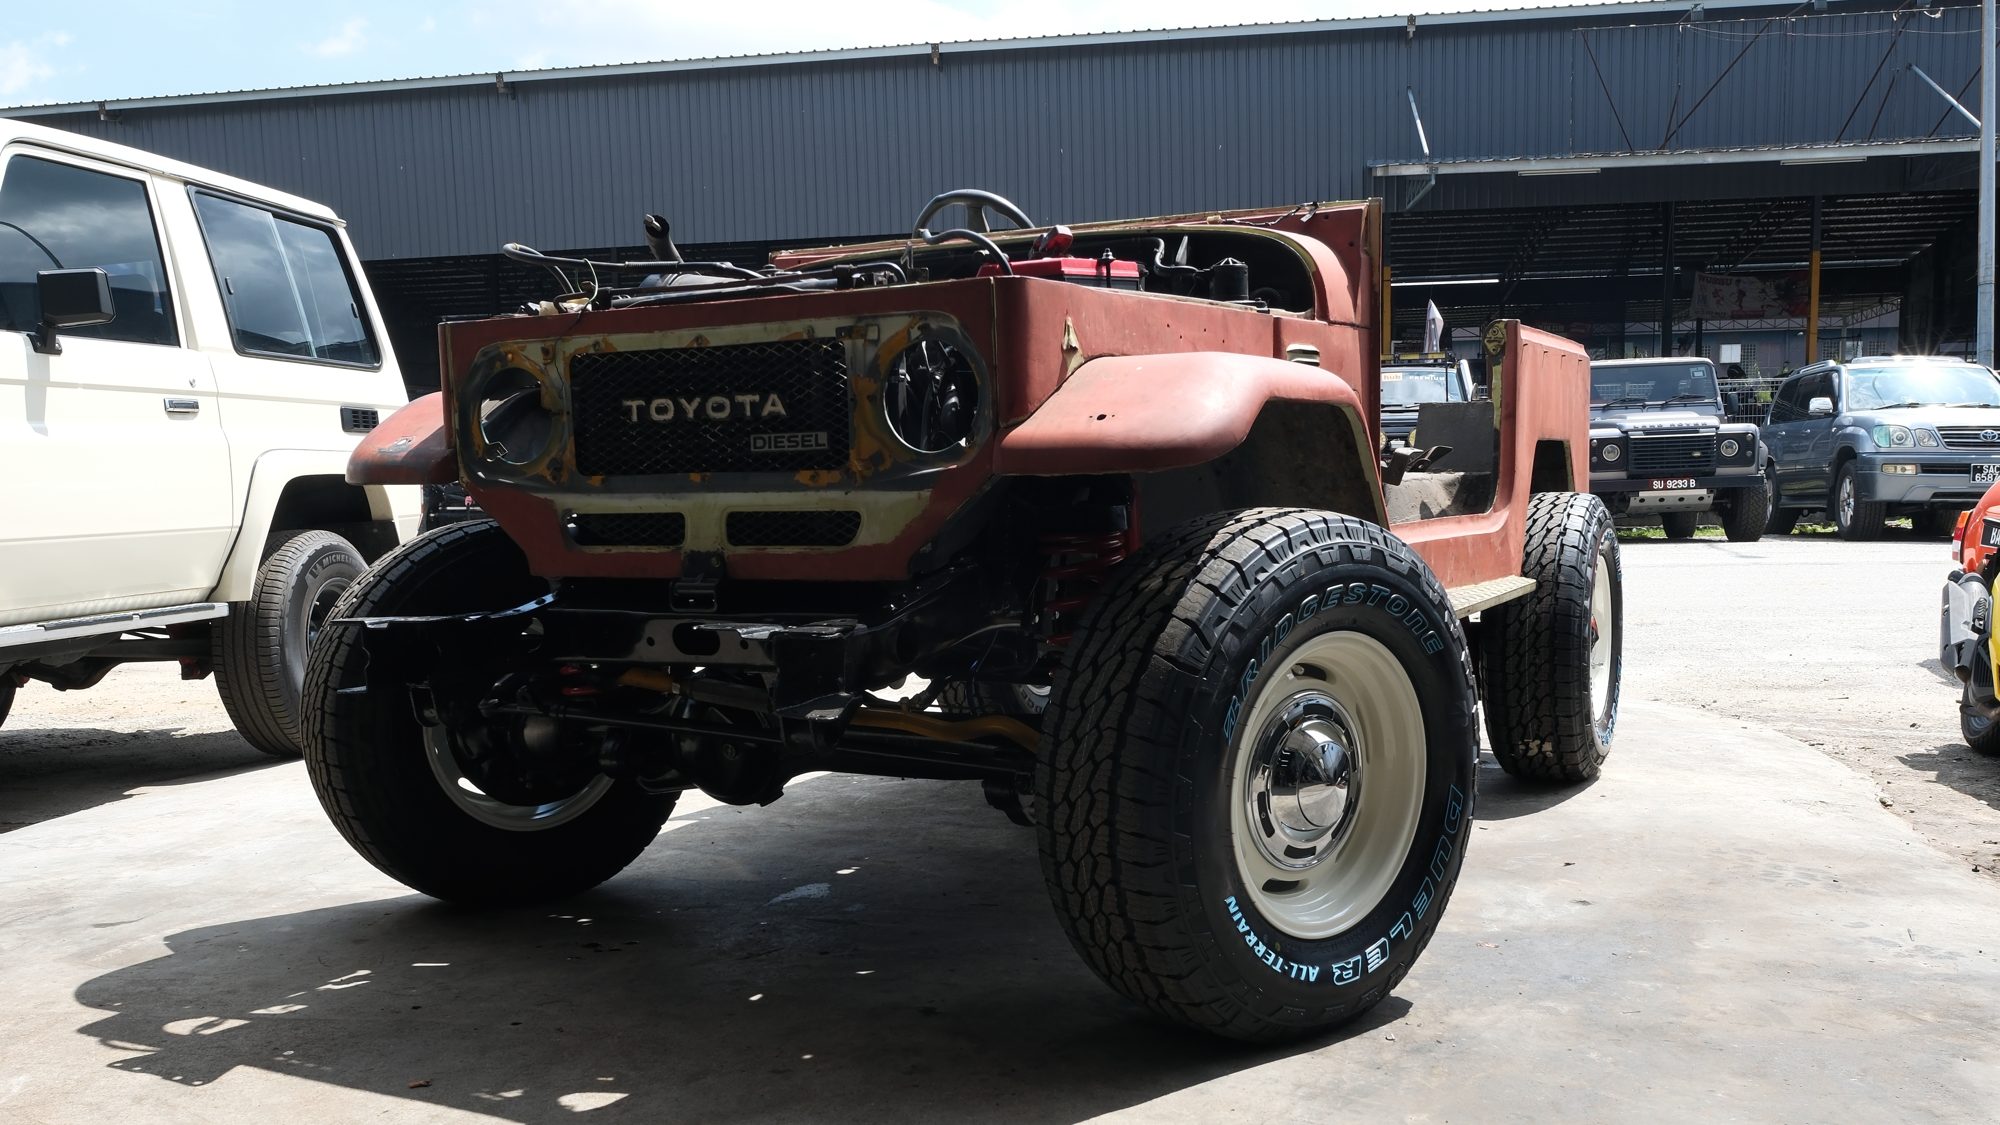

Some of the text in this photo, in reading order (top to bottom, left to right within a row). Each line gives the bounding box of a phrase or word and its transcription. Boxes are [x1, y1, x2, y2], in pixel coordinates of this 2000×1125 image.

[622, 393, 787, 422] TOYOTA
[752, 433, 827, 450] DIESEL
[1653, 480, 1664, 489] SU
[1689, 478, 1696, 488] B
[1982, 465, 2000, 474] SAC
[1223, 582, 1444, 745] BRIDGESTONE
[1332, 784, 1464, 986] DUELER
[1224, 895, 1320, 982] ALL-TERRAIN
